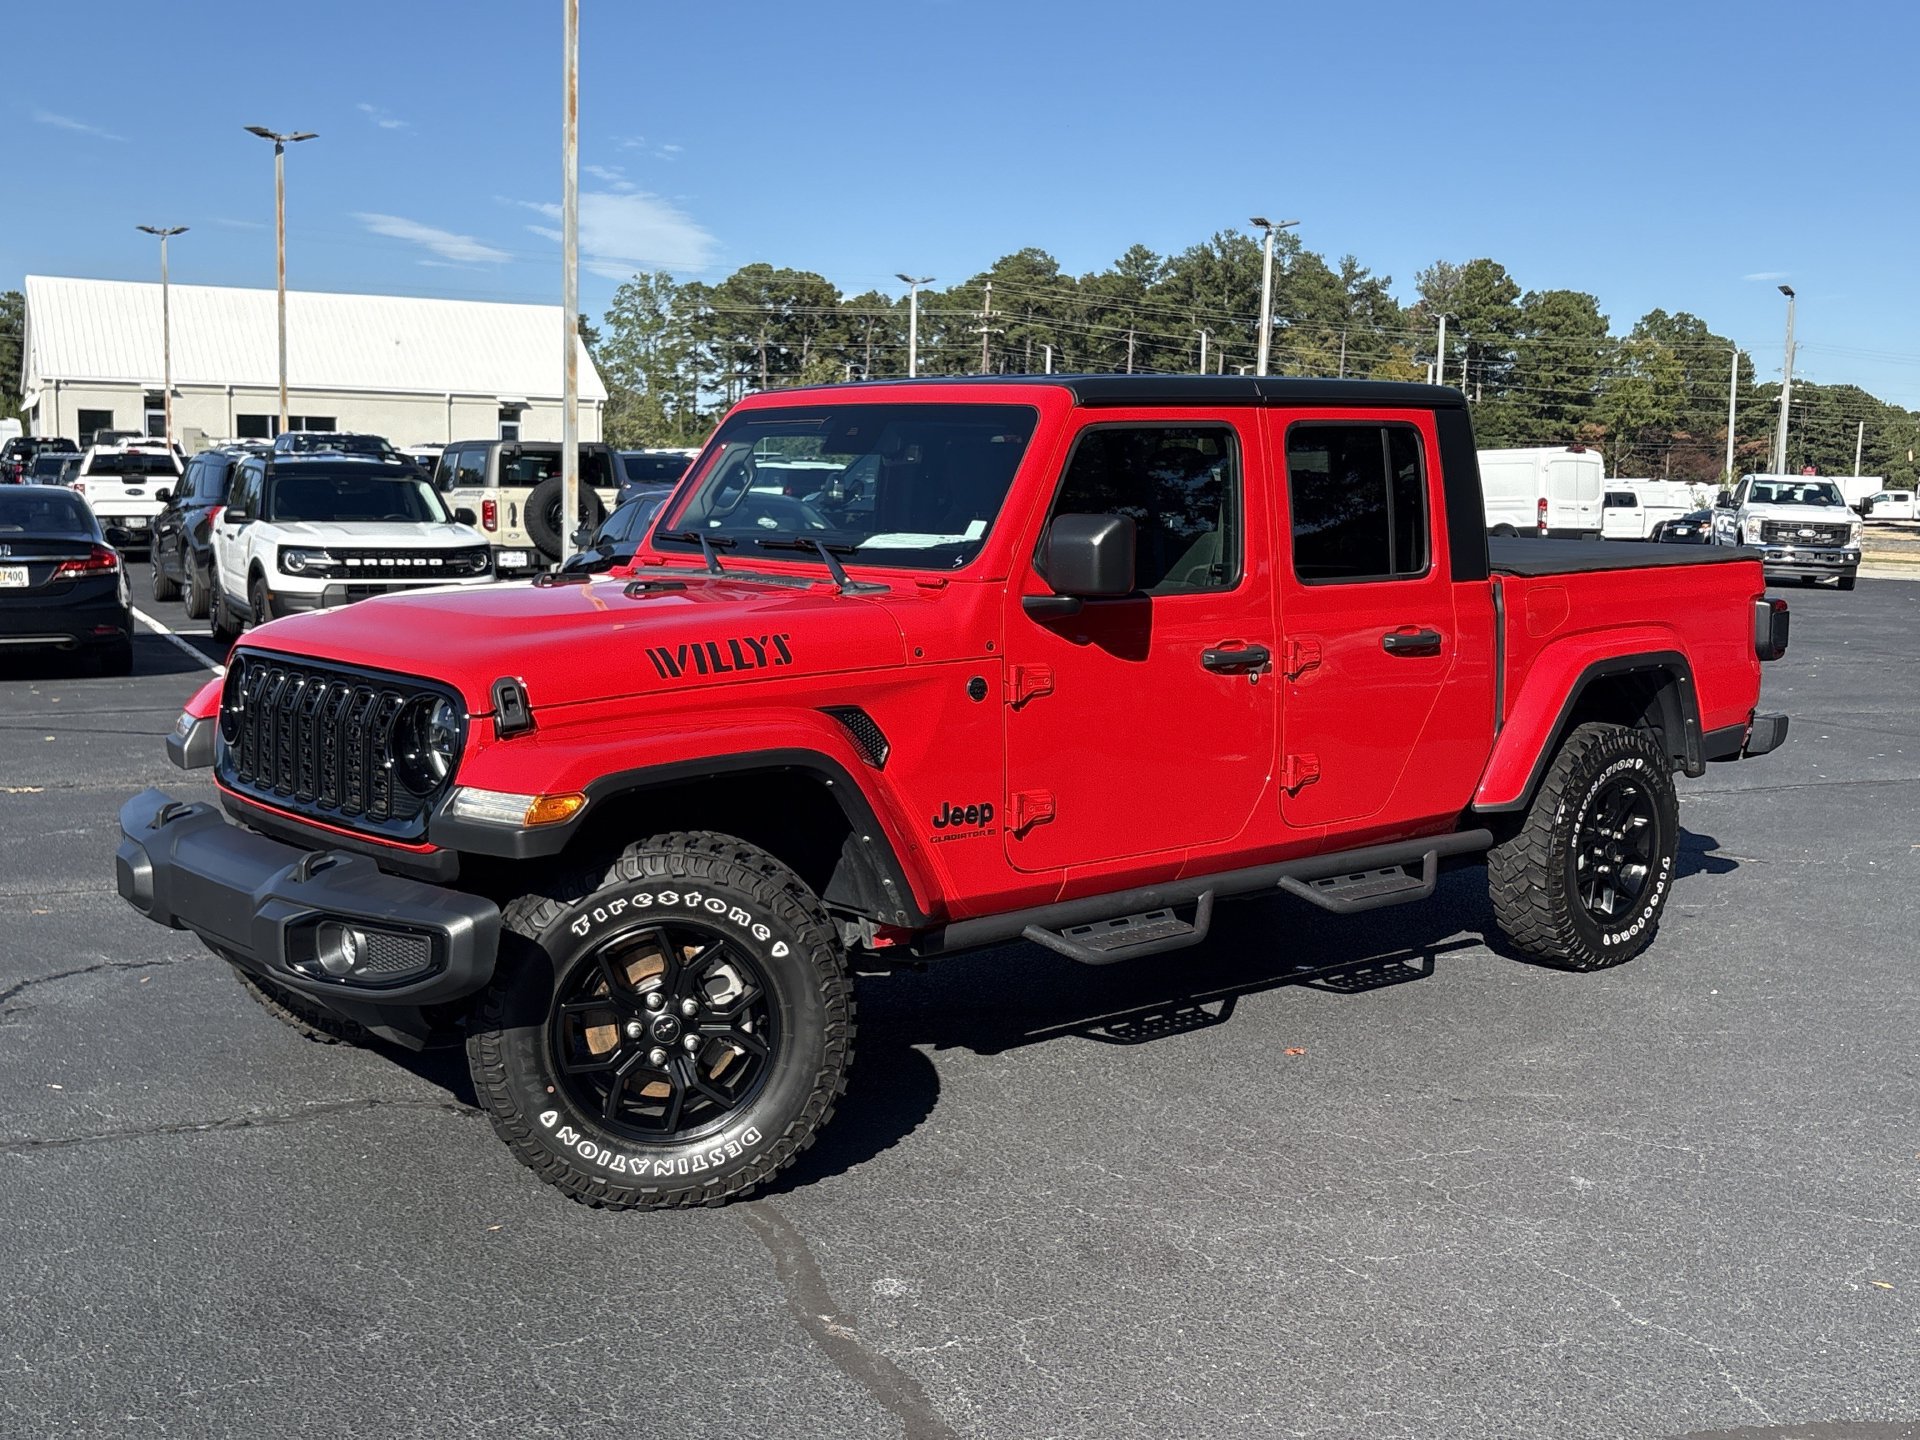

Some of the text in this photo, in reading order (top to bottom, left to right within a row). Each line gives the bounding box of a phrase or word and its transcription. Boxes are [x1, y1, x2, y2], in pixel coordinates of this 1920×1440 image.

[644, 633, 793, 679] WILLYS
[930, 830, 986, 844] GLADIATOR
[932, 801, 994, 829] Jeep
[571, 890, 772, 942] Firestone
[555, 1126, 762, 1177] DESTINATION
